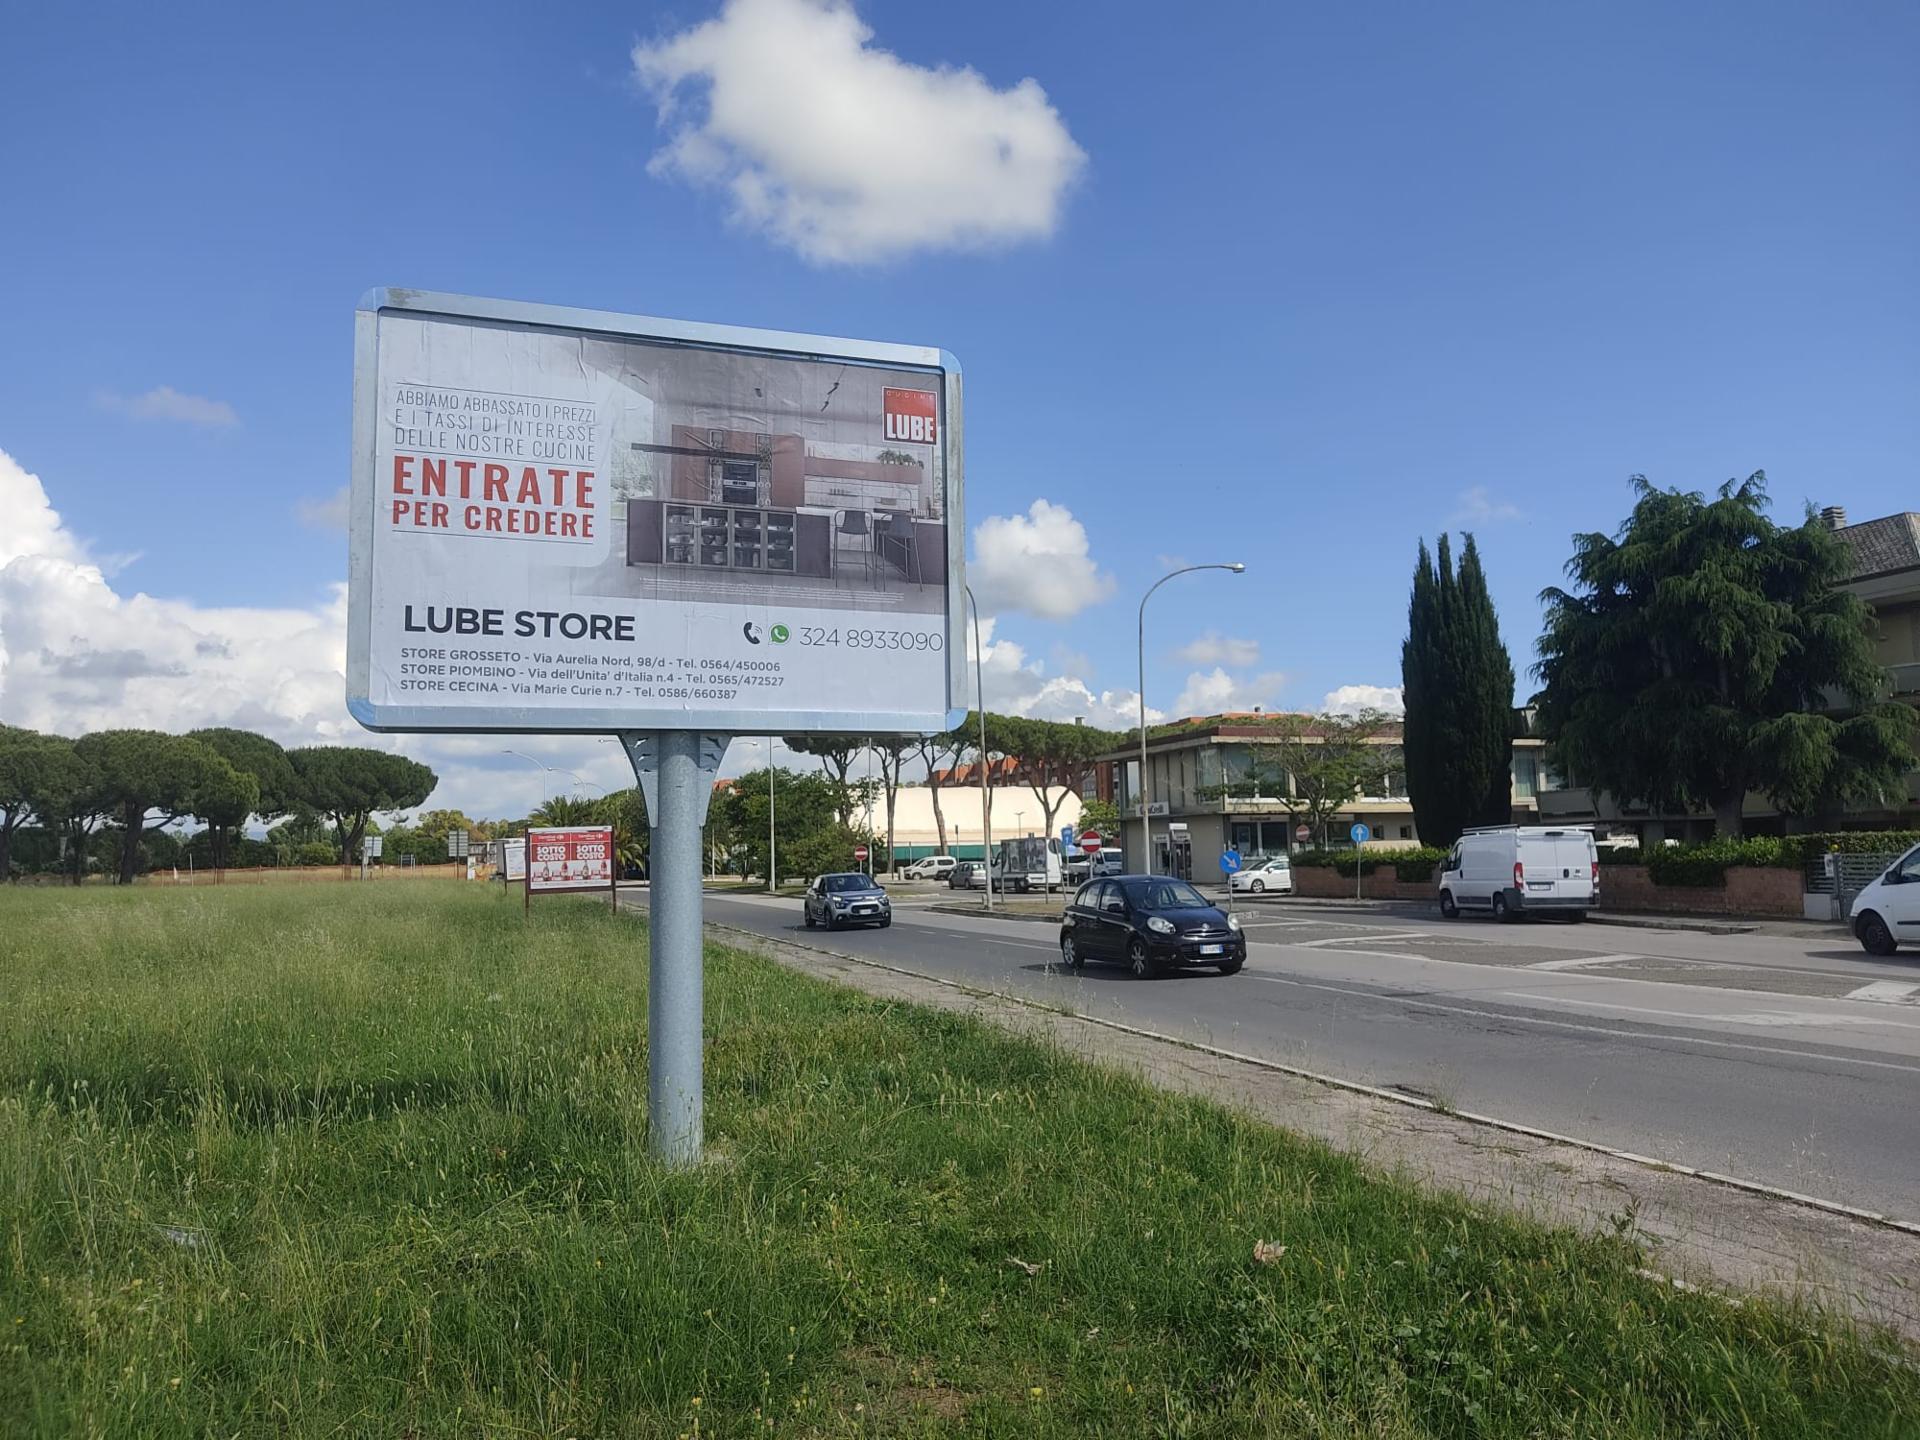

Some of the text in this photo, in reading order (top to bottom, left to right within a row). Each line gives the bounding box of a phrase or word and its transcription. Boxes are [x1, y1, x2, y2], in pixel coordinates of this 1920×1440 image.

[396, 390, 459, 410] ABBIAMO
[463, 397, 541, 418] ABBASSATO
[553, 406, 596, 423] PREZZI
[395, 408, 402, 424] E
[424, 411, 473, 431] TASSI
[482, 416, 498, 433] DI
[507, 418, 596, 443] INTERESSE
[886, 412, 934, 442] LUBE
[395, 427, 595, 462] DELLE NOSTRE CUCINE
[393, 455, 595, 509] ENTRATE
[392, 499, 594, 538] PER CREDERE
[404, 604, 636, 641] LUBE STORE
[799, 627, 943, 652] 324 8933090
[401, 648, 446, 660] STORE
[449, 649, 521, 663] GROSSETO
[533, 653, 552, 664] Via
[556, 654, 598, 666] Aurelia
[601, 655, 634, 668] Nord,
[637, 656, 665, 669] 98/d
[676, 658, 697, 669] Tel.
[700, 659, 781, 672] 0564/450006
[400, 664, 445, 676] STORE
[449, 665, 516, 678] PIOMBINO
[528, 668, 547, 679] Via
[551, 668, 611, 681] dell'Unita'
[613, 671, 653, 683] d'Italia
[656, 673, 674, 683] n.4
[685, 674, 706, 684] Tel.
[709, 674, 785, 687] 0565/472527
[400, 680, 445, 691] STORE
[449, 681, 499, 693] CECINA
[511, 683, 531, 695] Via
[534, 684, 567, 695] Marie
[570, 685, 602, 696] Curie
[605, 686, 623, 697] n.7
[634, 687, 655, 698] Tel.
[658, 687, 737, 700] 0586/660387
[537, 846, 566, 854] SOTTO
[537, 853, 566, 861] COSTO
[576, 844, 605, 853] SOTTO
[576, 852, 605, 860] COSTO
